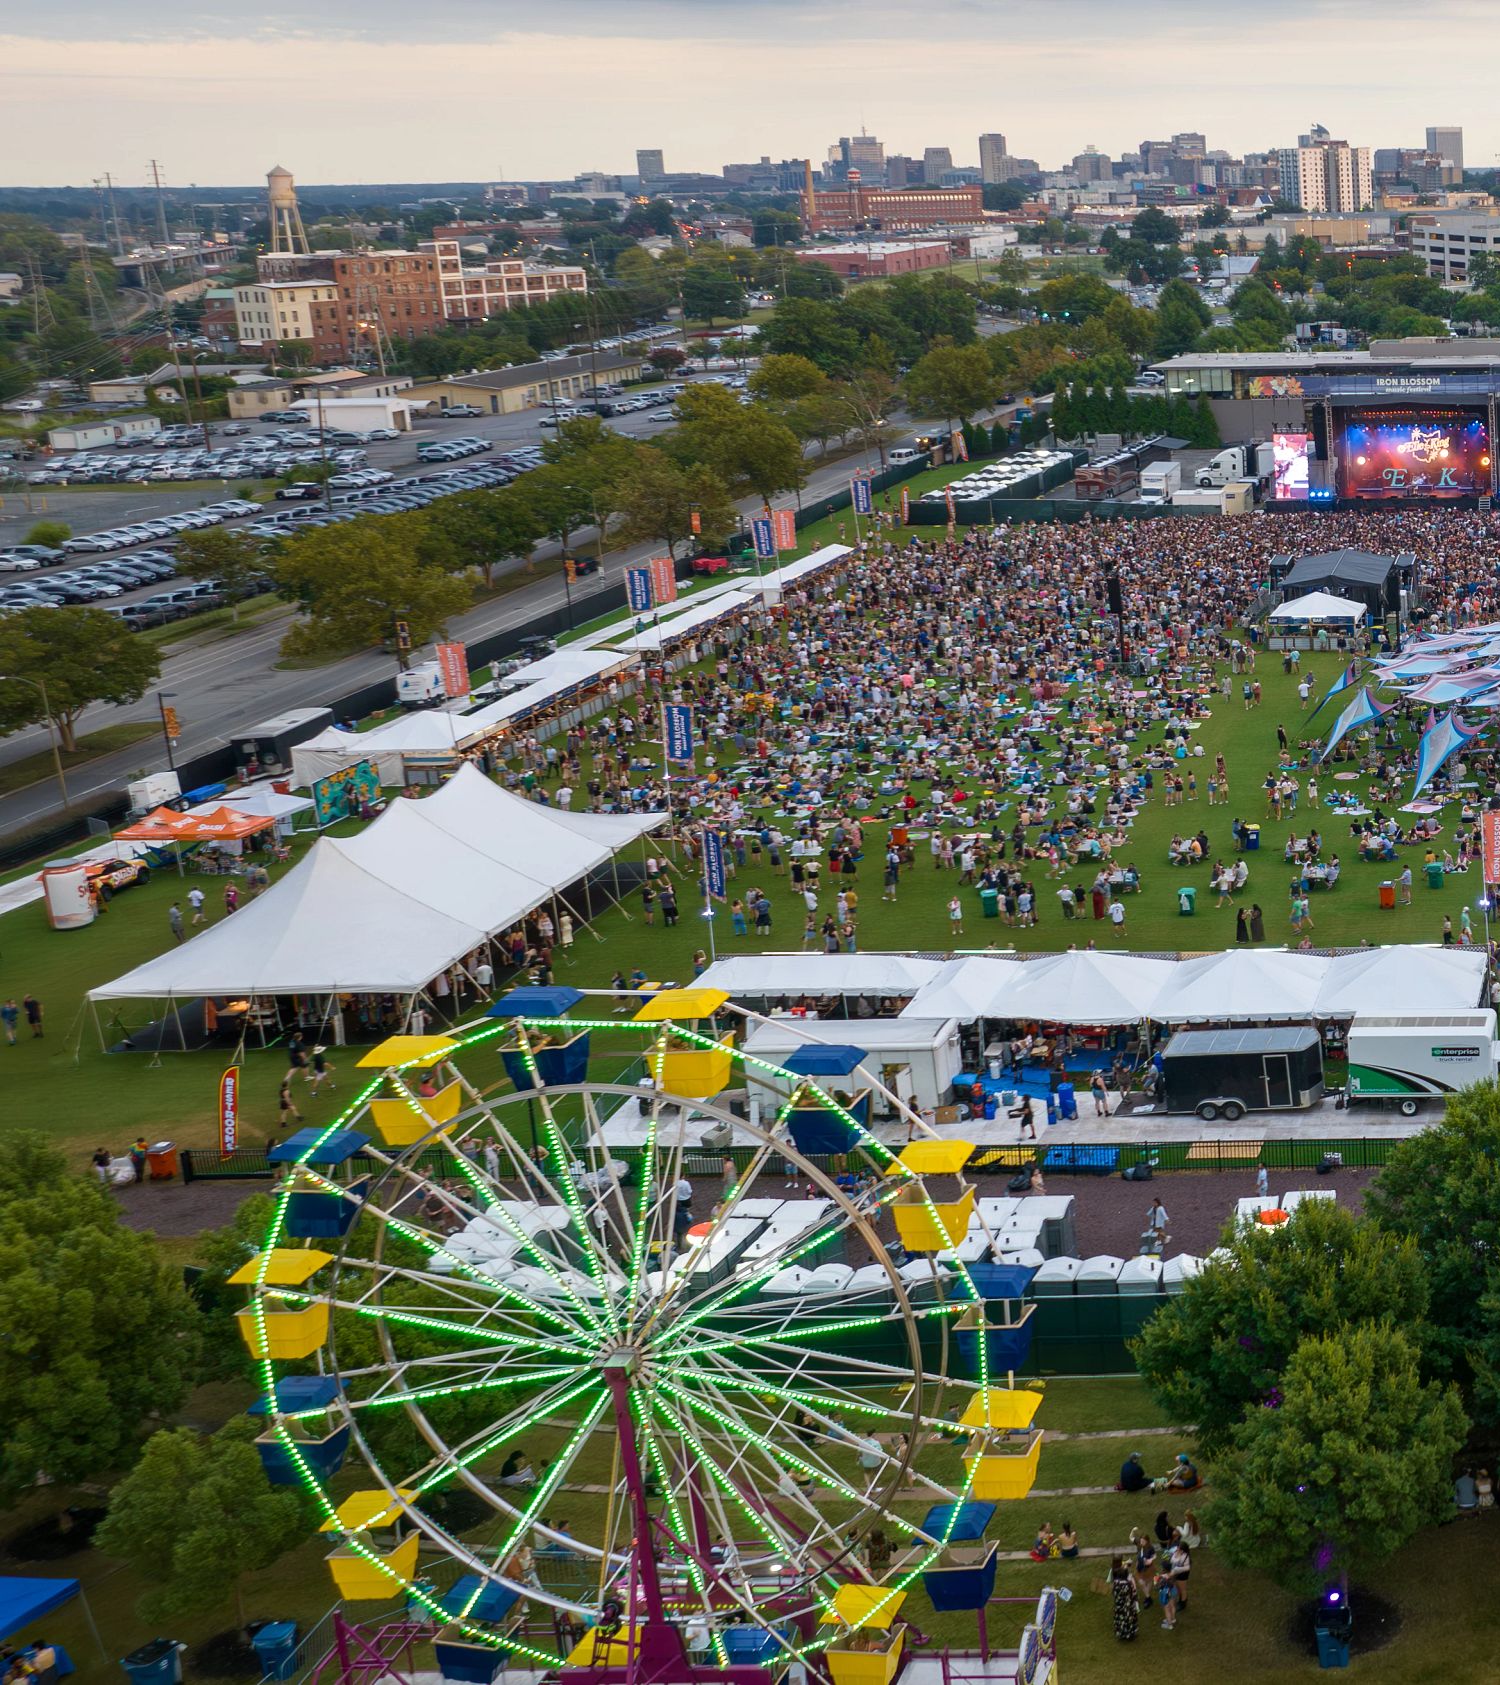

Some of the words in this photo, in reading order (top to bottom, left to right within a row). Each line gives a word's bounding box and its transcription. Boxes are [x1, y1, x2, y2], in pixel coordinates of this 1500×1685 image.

[1376, 378, 1399, 386] IRON
[1400, 378, 1440, 386] BLOSSOM
[1406, 385, 1432, 394] festival
[1382, 468, 1408, 487] E
[1438, 467, 1458, 486] K
[671, 707, 681, 739] BLOSSOM
[674, 739, 682, 757] IRON
[1493, 858, 1500, 878] IRON
[1433, 1048, 1479, 1056] enterprise
[224, 1077, 235, 1151] RESTROOMS
